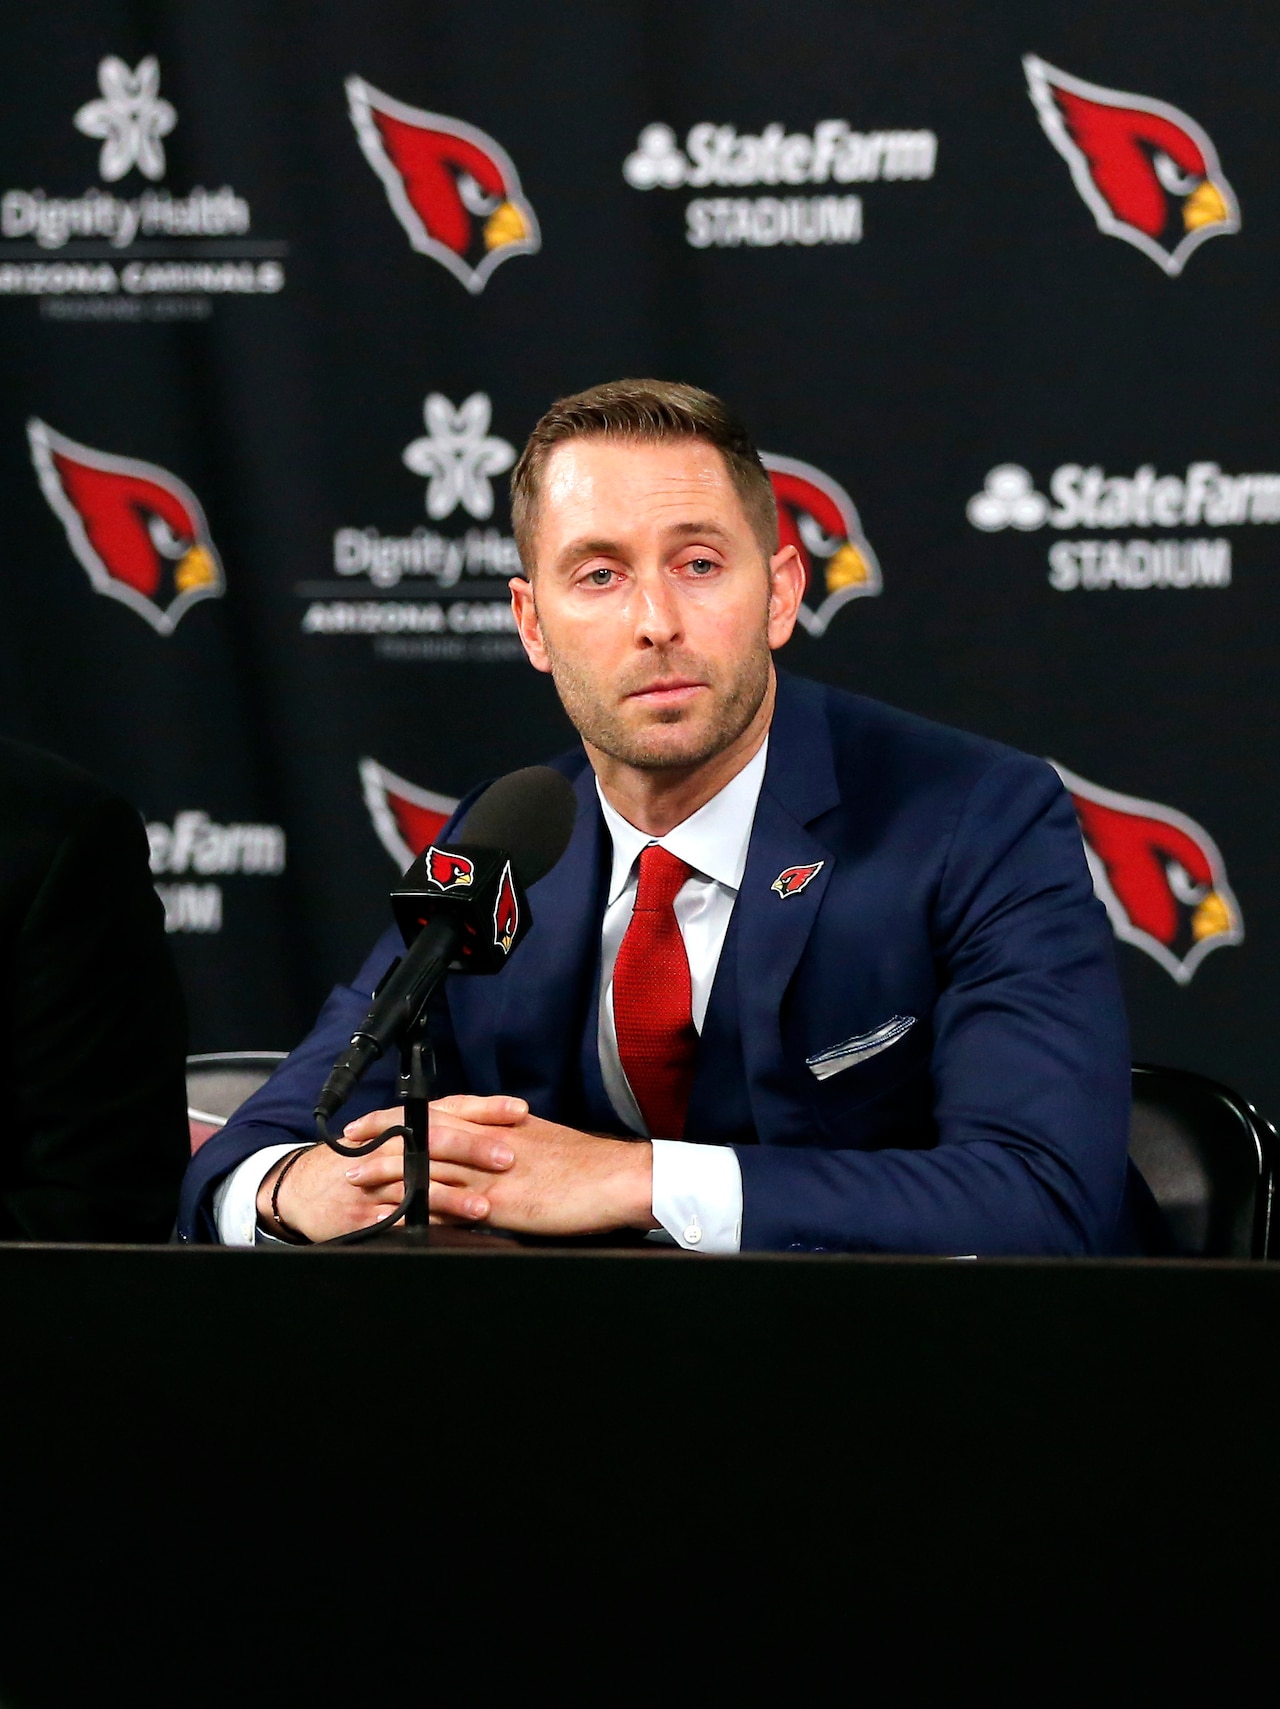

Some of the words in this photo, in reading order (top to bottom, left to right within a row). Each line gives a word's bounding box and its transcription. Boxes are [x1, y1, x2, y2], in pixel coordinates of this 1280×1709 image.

[1, 188, 139, 249] Dignity
[140, 185, 250, 235] Health
[686, 195, 863, 249] STADIUM
[0, 262, 119, 294] RIZONA
[121, 261, 285, 293] CARDINALS
[334, 526, 465, 588] Dignity
[1048, 538, 1232, 591] STADIUM
[303, 602, 446, 634] ARIZONA
[148, 809, 286, 875] eFarm
